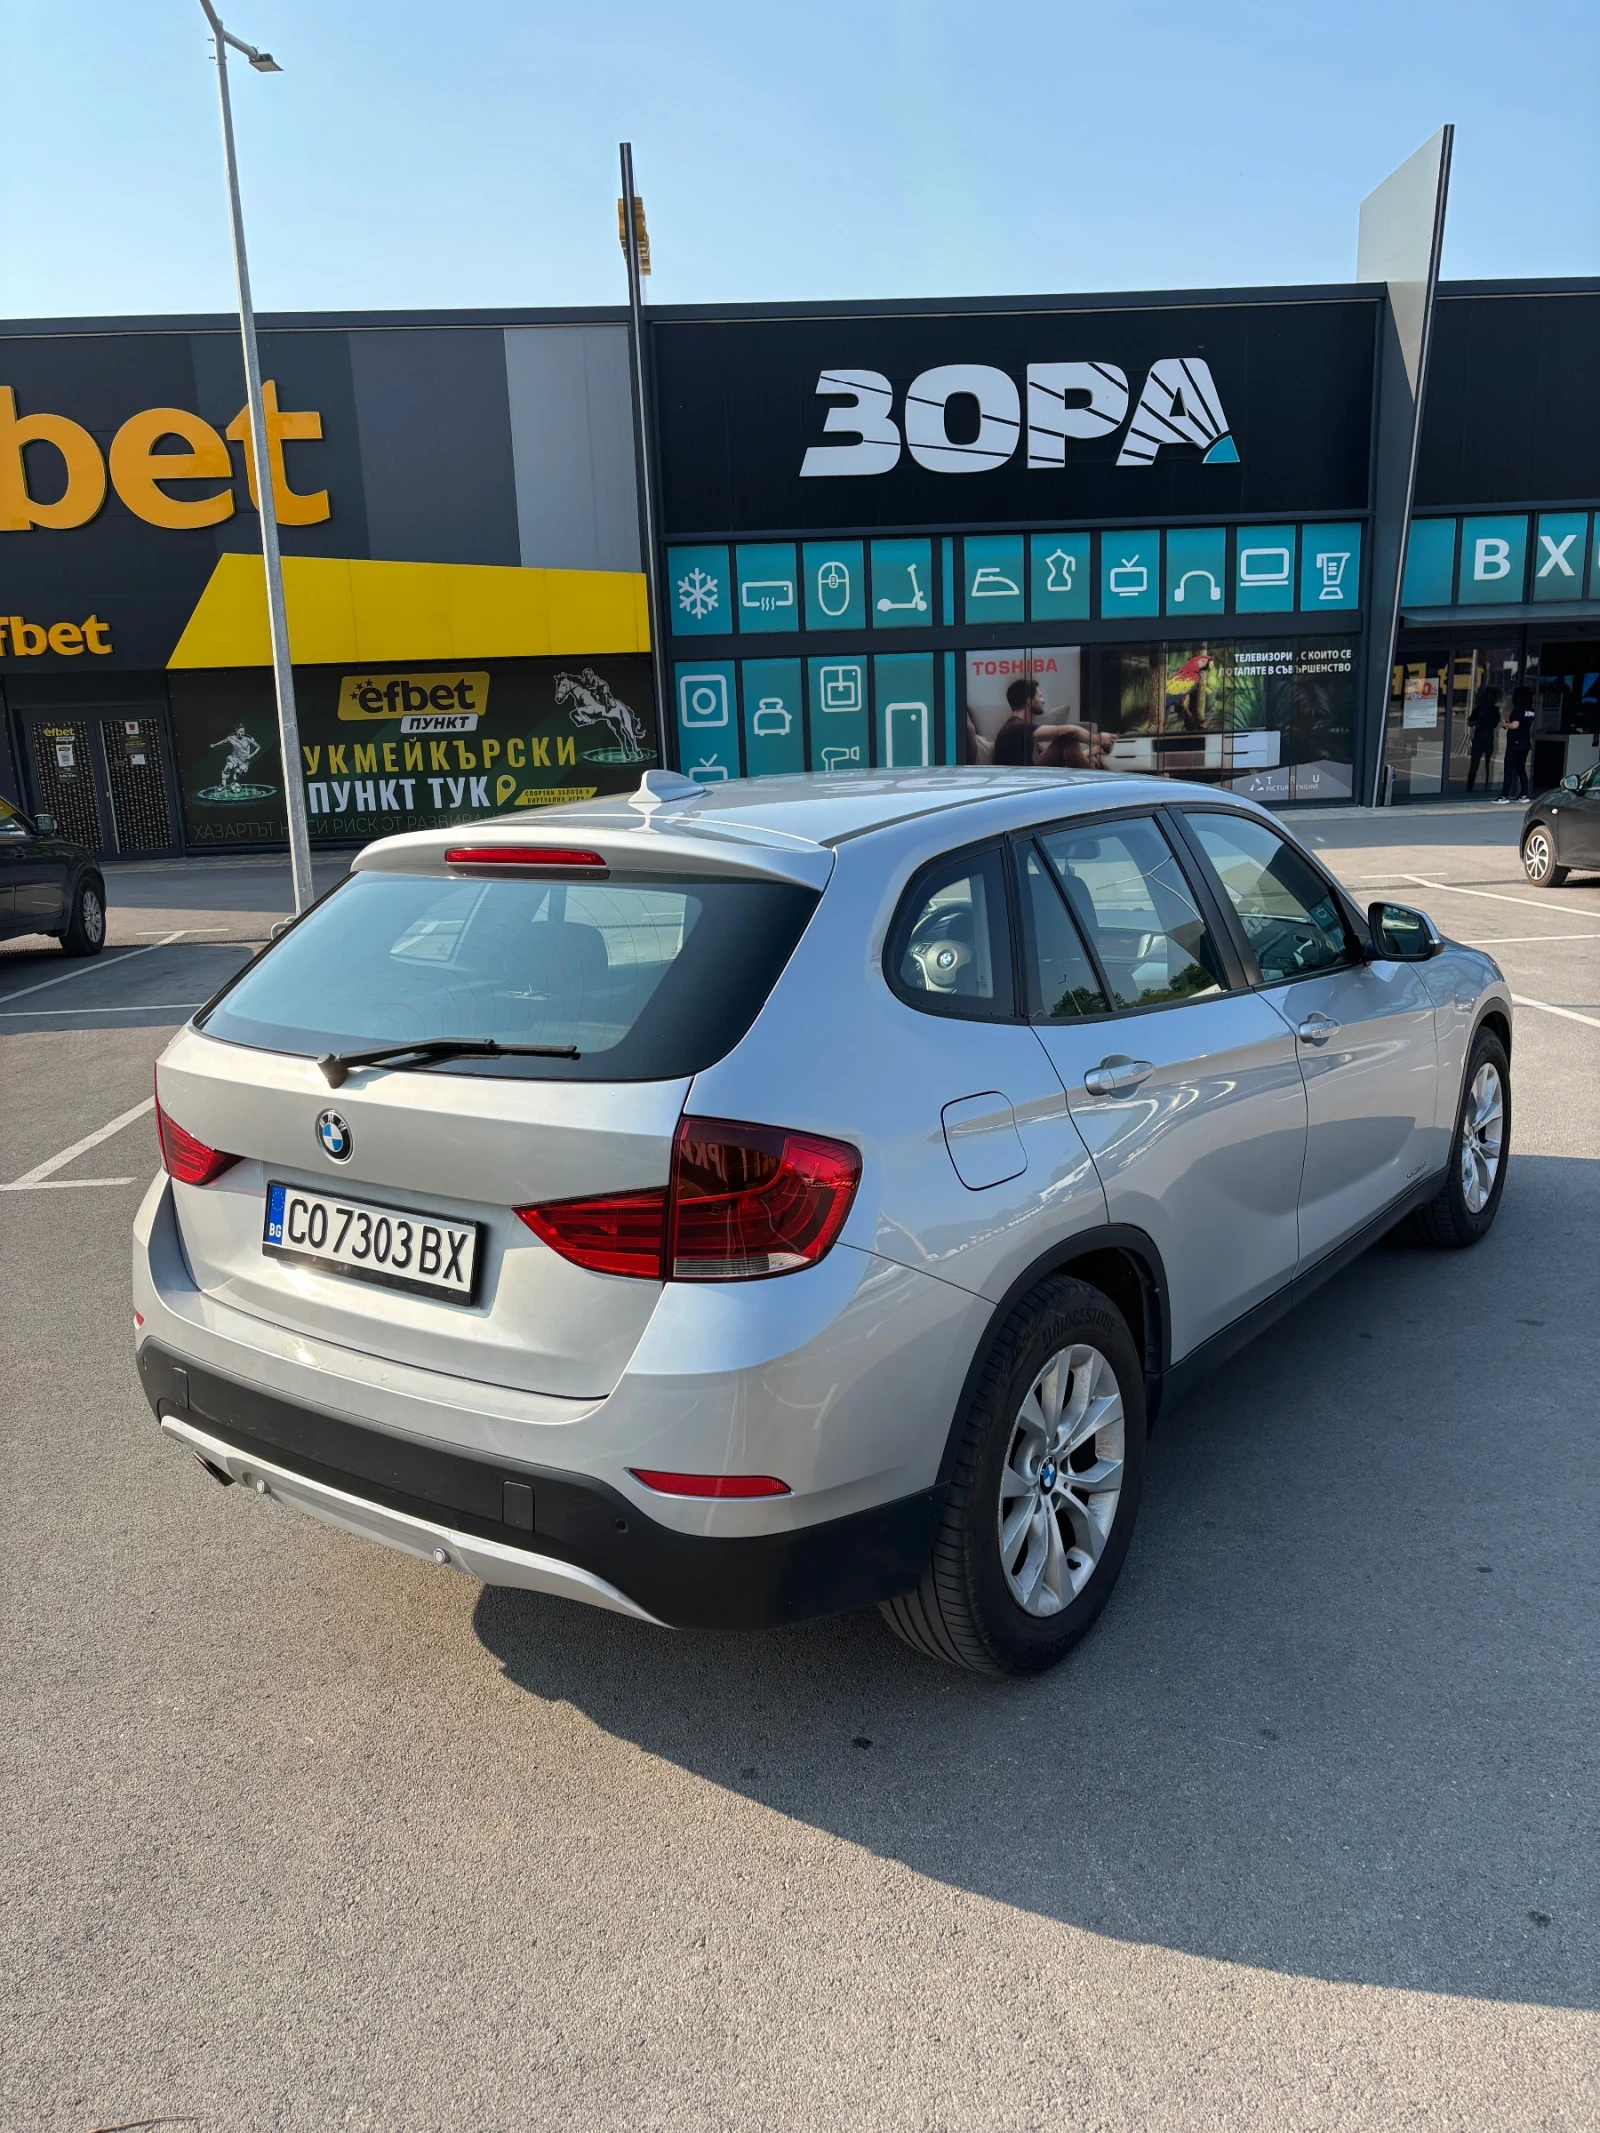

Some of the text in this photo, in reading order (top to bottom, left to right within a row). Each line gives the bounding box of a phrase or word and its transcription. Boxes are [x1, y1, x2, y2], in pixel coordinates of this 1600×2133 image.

[798, 356, 1241, 477] ЗОРА
[1473, 534, 1600, 581] ВХ
[1340, 649, 1352, 659] СЕ
[971, 658, 1058, 676] TOSHIBA
[357, 678, 477, 713] efbet
[44, 727, 75, 737] efbet
[408, 715, 470, 731] ПУНКТ
[302, 735, 576, 776] УКМЕЙКЪРСКИ
[307, 775, 491, 814] ПУНКТ ТУК
[1265, 784, 1290, 792] PICTUR
[280, 819, 328, 836] НСИ
[333, 815, 380, 833] РИСК
[268, 1222, 282, 1238] BG
